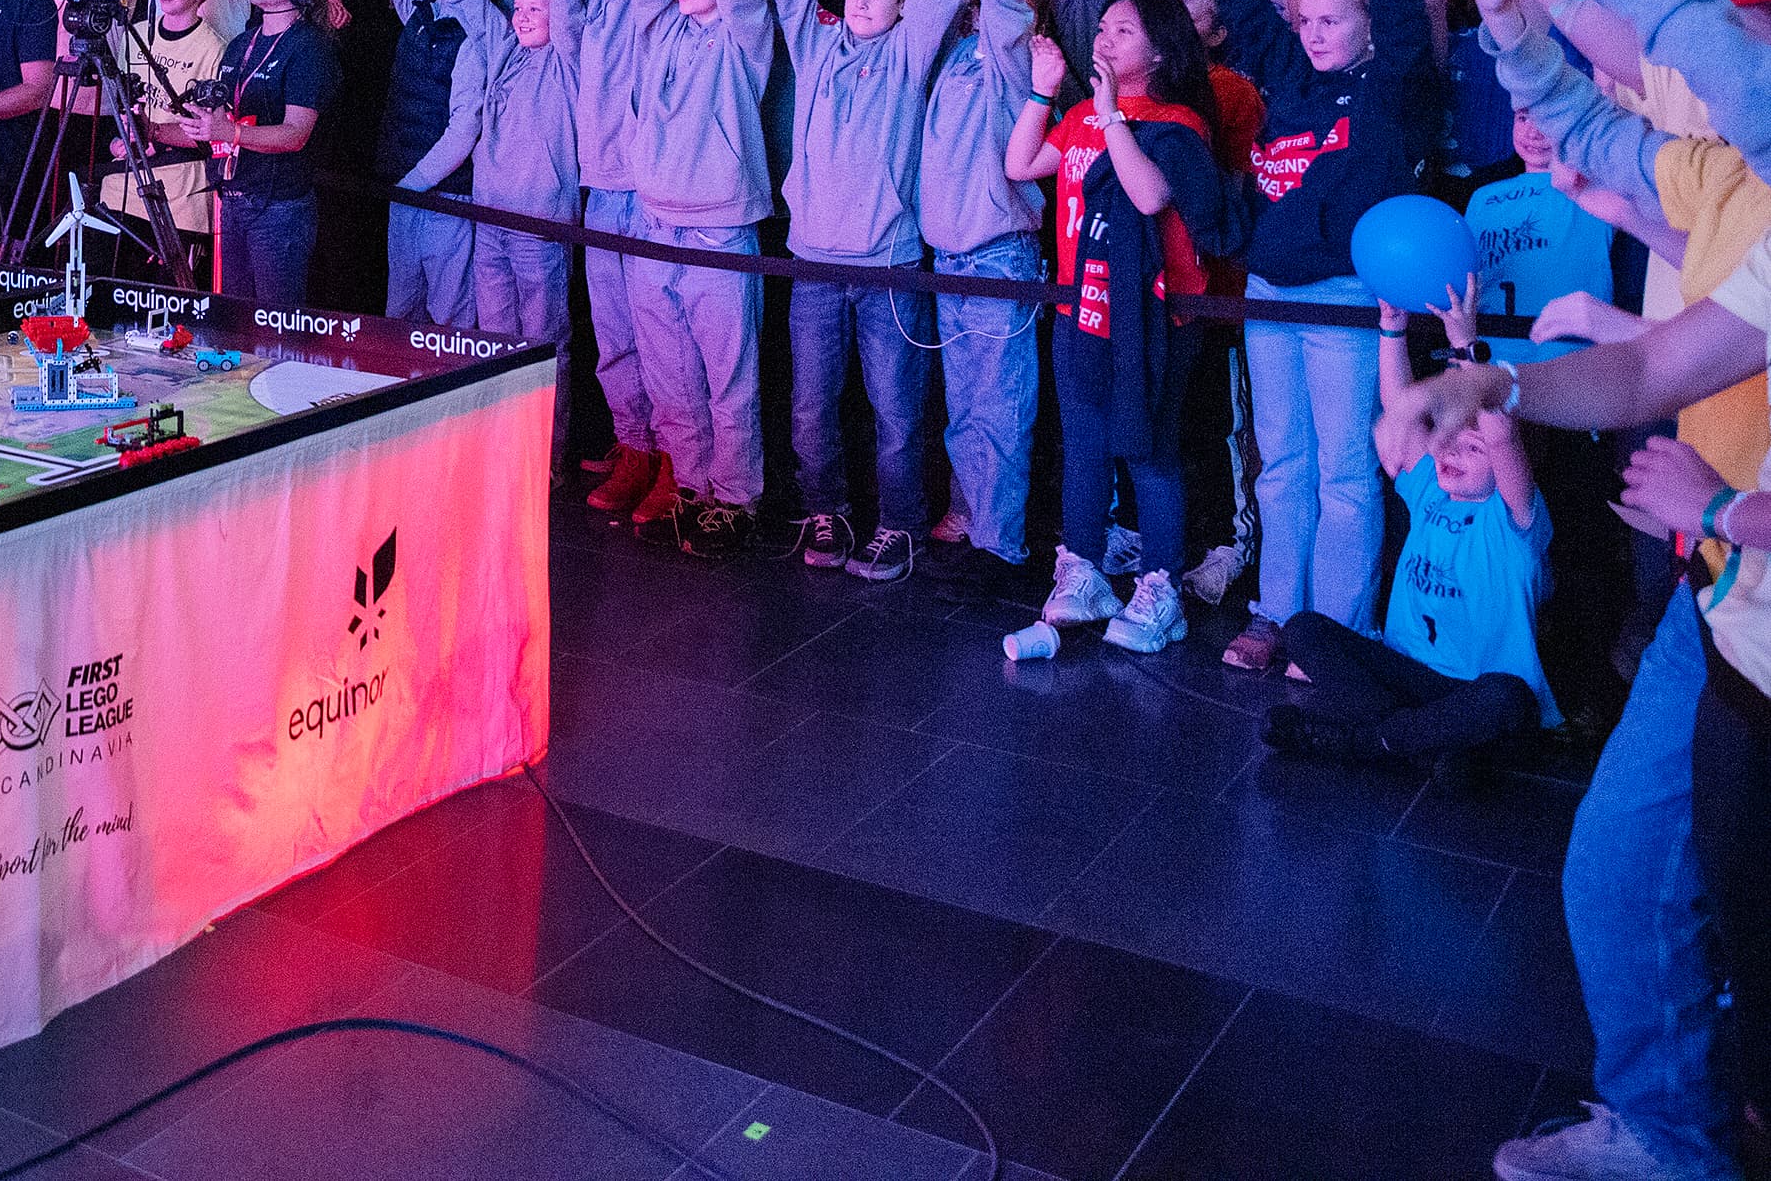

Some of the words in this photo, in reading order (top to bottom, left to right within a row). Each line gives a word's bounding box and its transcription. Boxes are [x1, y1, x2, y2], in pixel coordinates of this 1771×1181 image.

[114, 285, 189, 314] equinor
[255, 309, 338, 335] equinor
[410, 331, 503, 358] equinor
[66, 653, 123, 688] FIRST
[65, 681, 118, 713] LEGO
[288, 664, 390, 740] equinor
[65, 697, 134, 738] LEAGUE
[58, 805, 90, 851] the
[96, 801, 133, 836] mind
